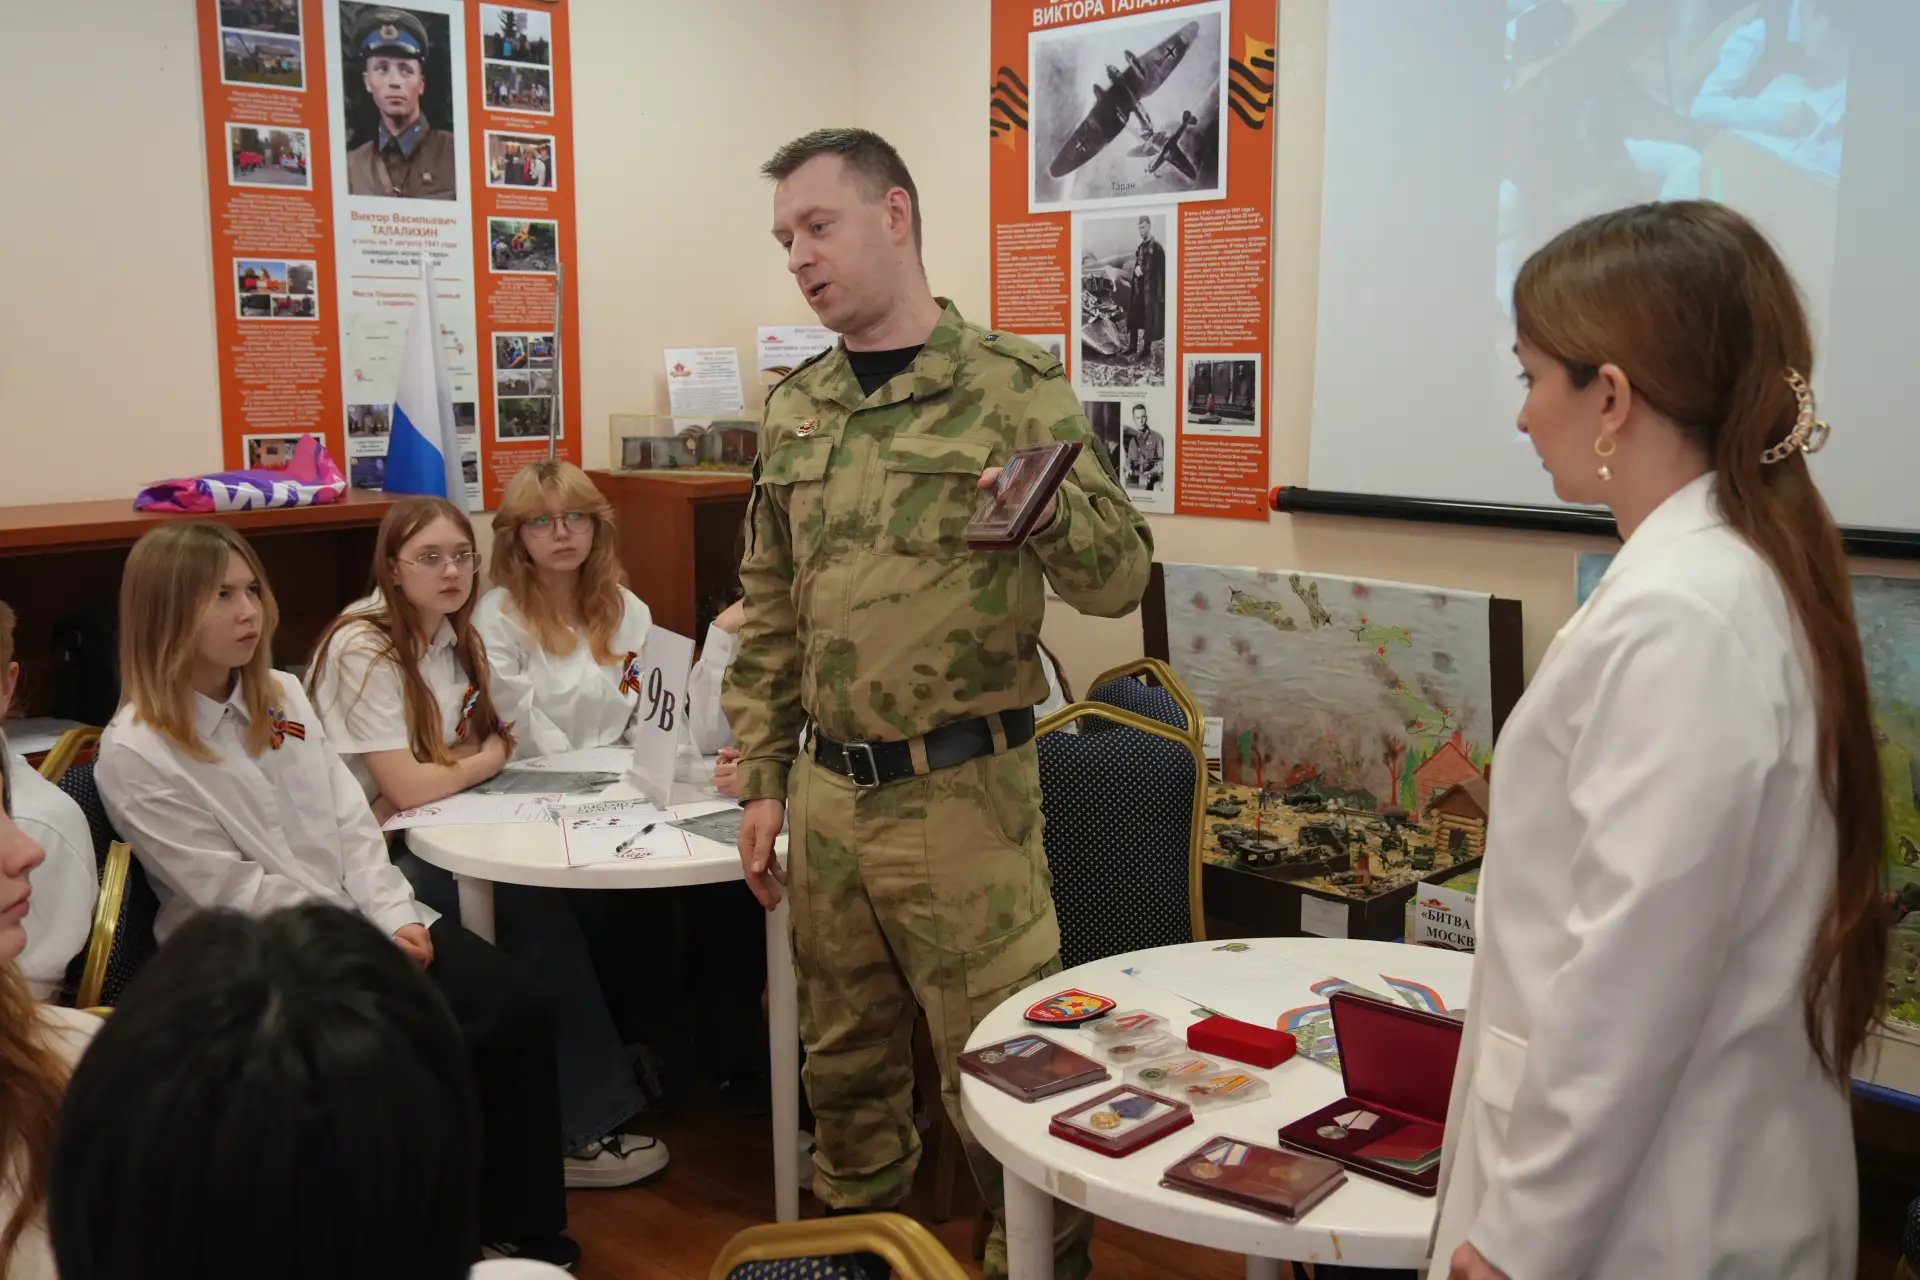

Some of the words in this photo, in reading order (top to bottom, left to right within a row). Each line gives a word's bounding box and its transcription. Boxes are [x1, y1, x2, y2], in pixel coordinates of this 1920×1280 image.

[1033, 1, 1104, 27] ВИКТОРА
[1111, 181, 1136, 192] Таран
[350, 210, 389, 224] Виктор
[392, 213, 457, 226] Васильевич
[372, 225, 439, 237] ТАЛАЛИХИН
[1421, 909, 1471, 930] «БИТВА
[1426, 926, 1475, 948] МОСКВ
